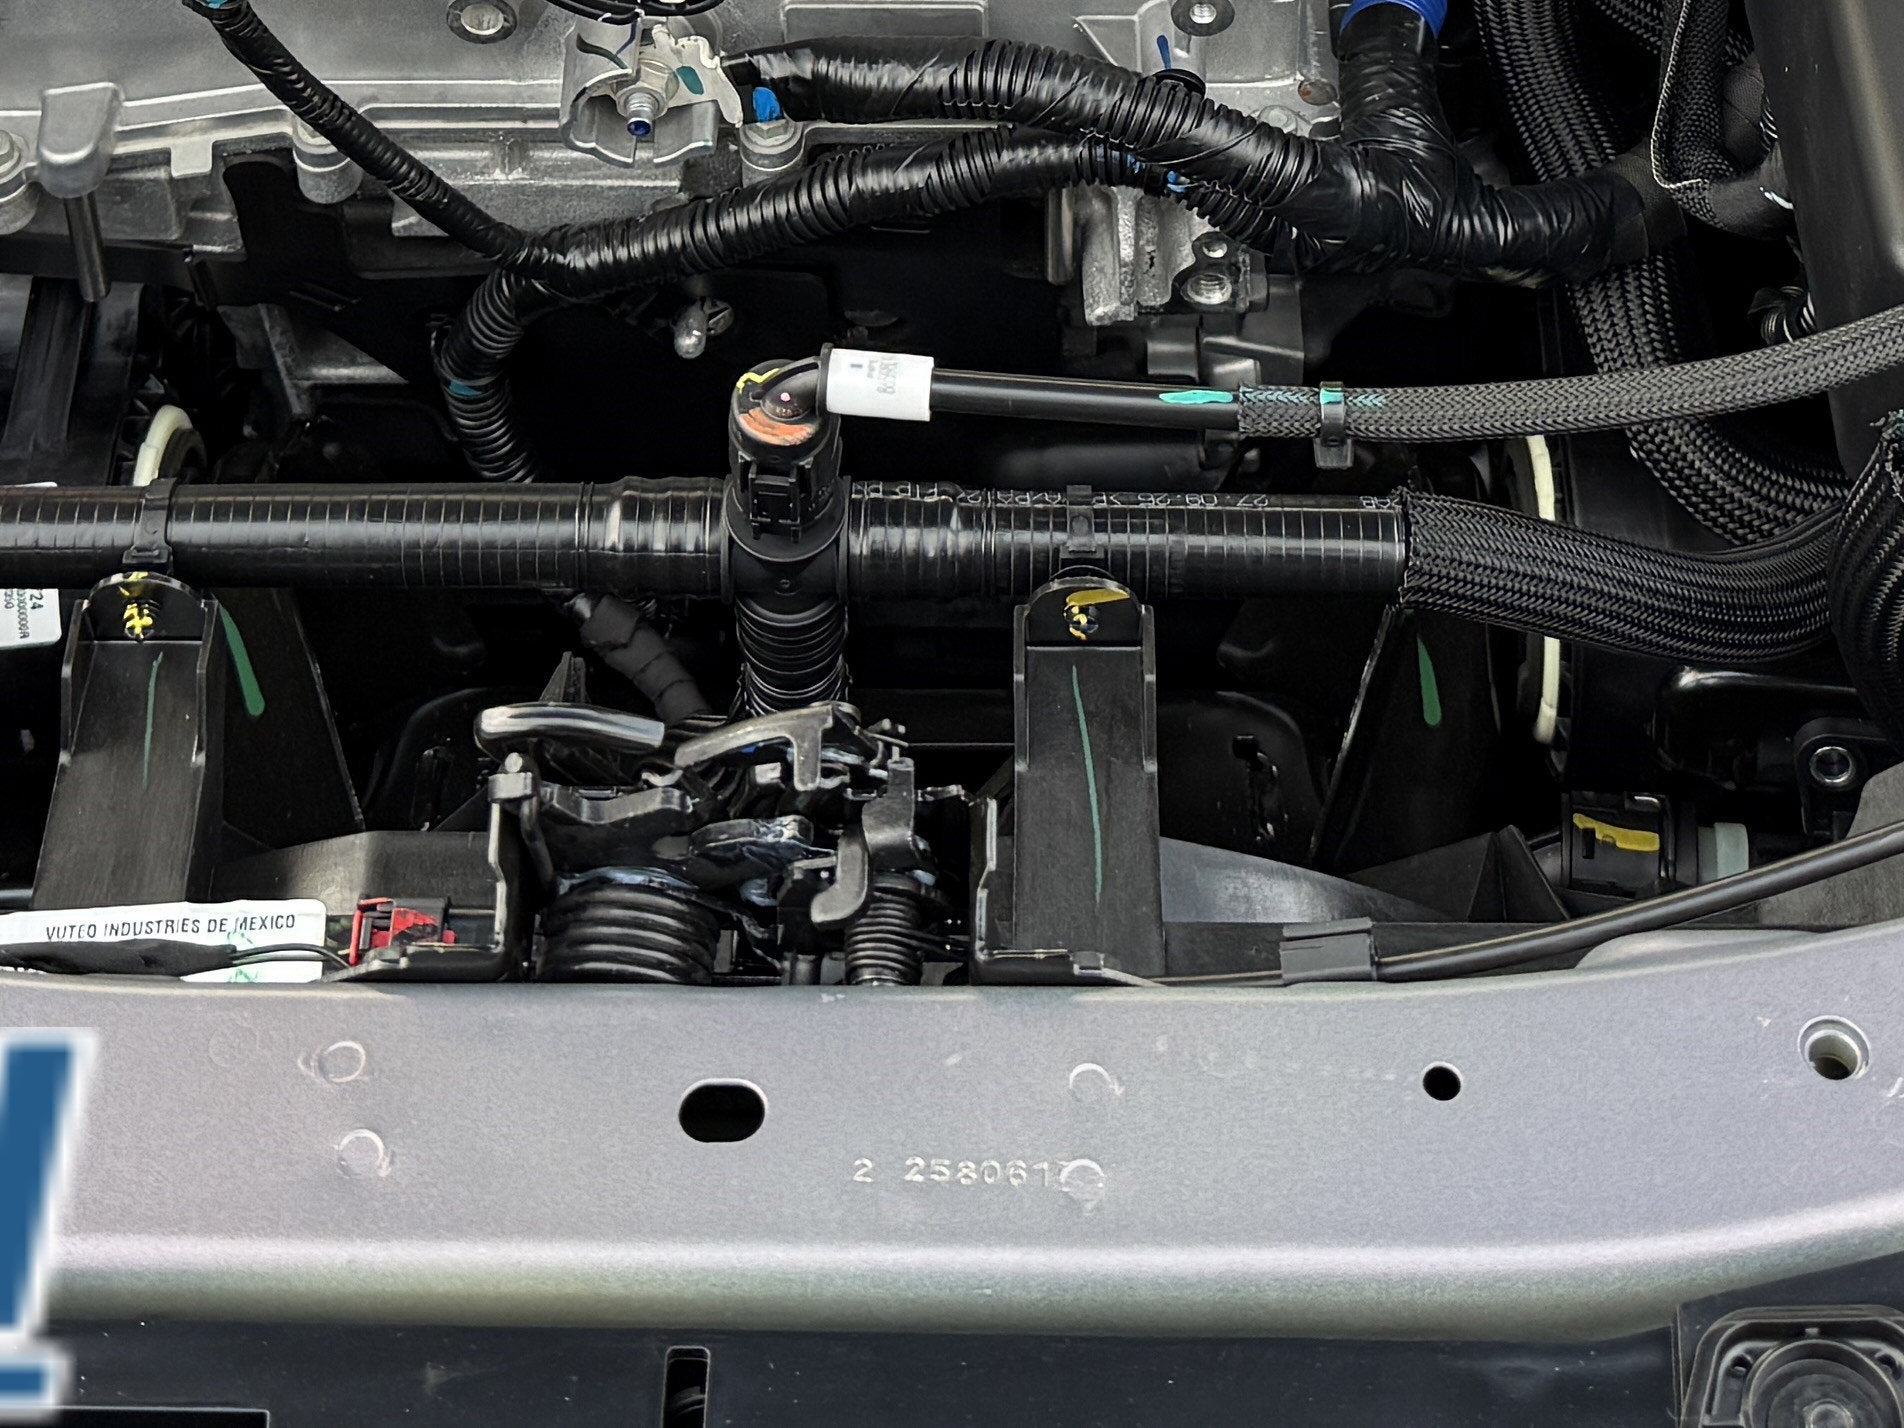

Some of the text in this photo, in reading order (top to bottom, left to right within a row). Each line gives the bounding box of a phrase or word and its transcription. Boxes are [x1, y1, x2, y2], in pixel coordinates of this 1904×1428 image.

[103, 918, 200, 937] INDUSTRIES
[207, 917, 228, 933] DE
[234, 914, 296, 932] MEXICO
[852, 1157, 874, 1183] 2
